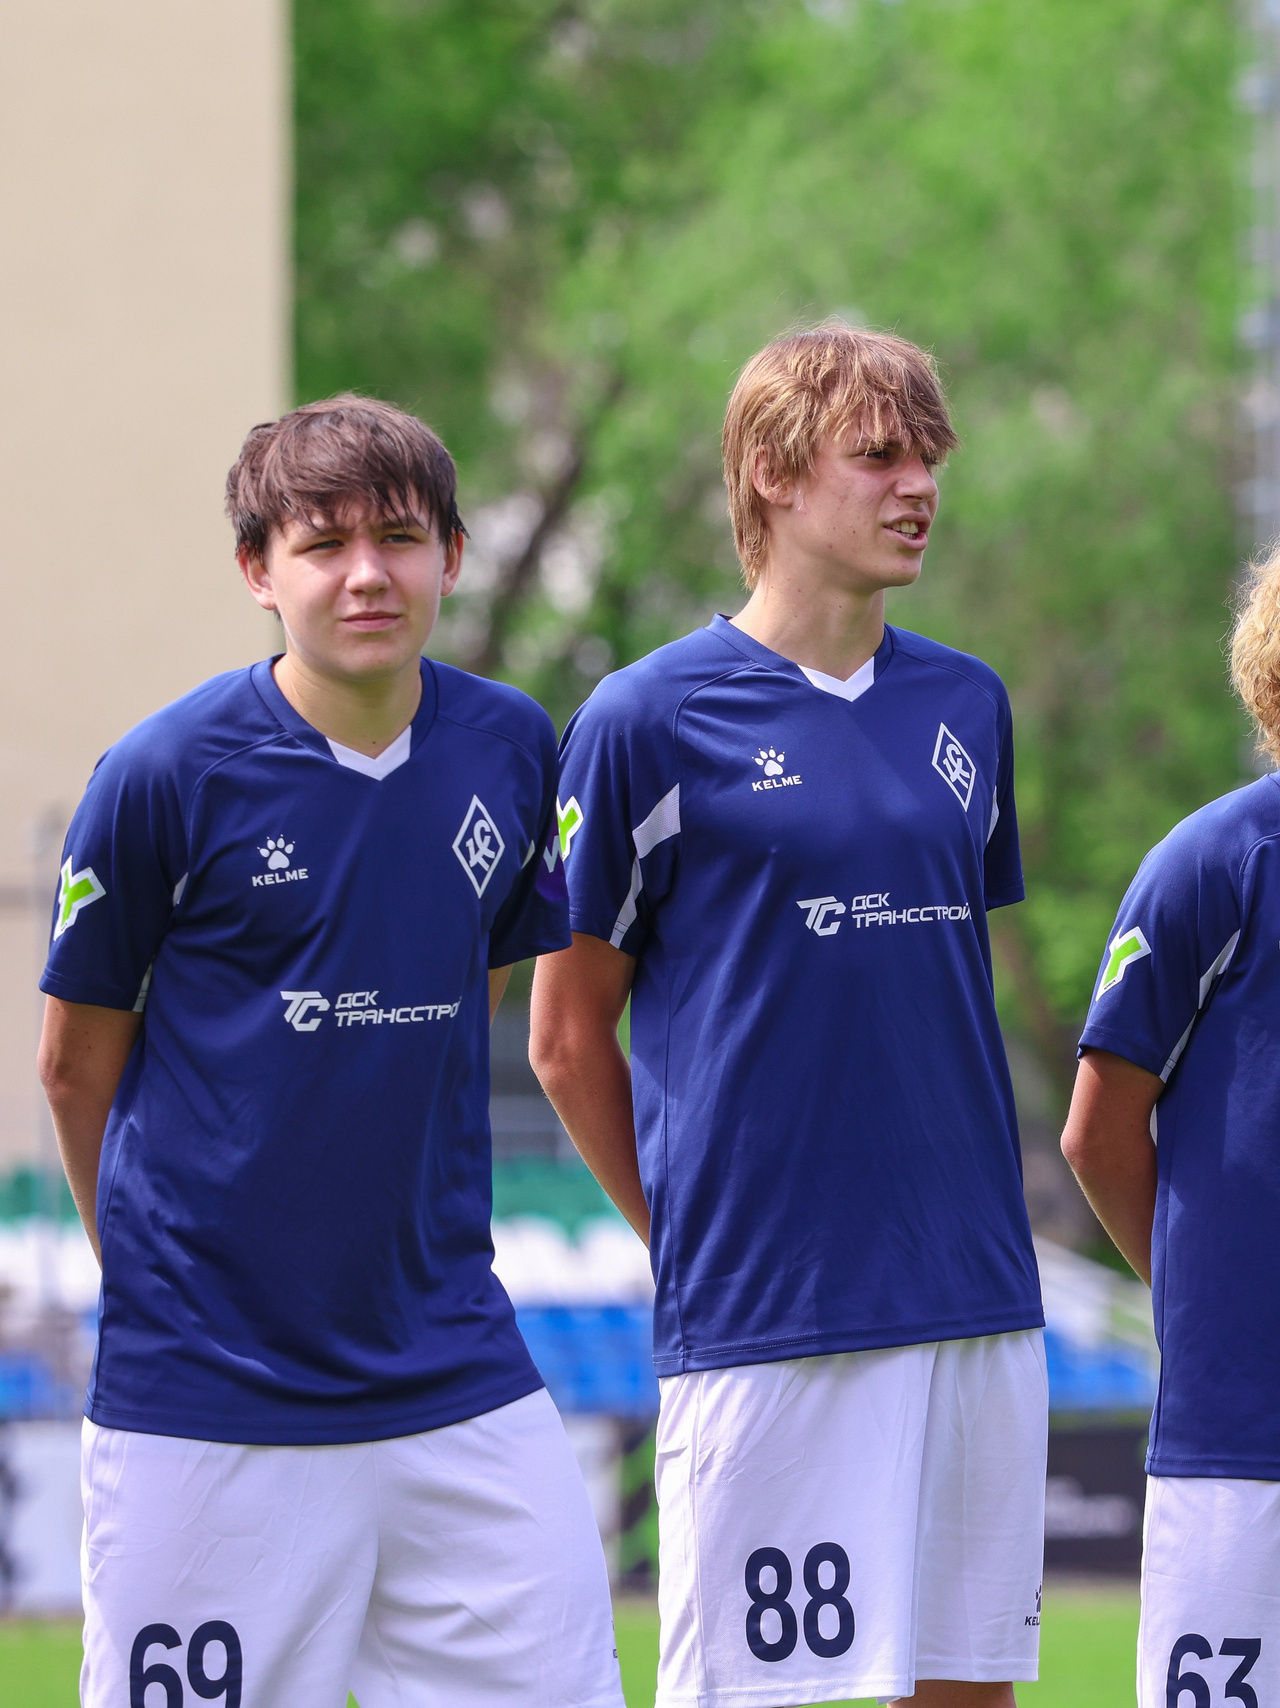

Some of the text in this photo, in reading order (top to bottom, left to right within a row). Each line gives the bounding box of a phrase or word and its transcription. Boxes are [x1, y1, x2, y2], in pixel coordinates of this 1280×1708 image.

[751, 775, 803, 792] KELME
[251, 868, 309, 887] KELME
[851, 892, 890, 912] ДСК
[851, 902, 972, 929] ТРАНССТРОЙ
[335, 990, 380, 1010] ДСК
[335, 998, 462, 1028] ТРАНССТРО
[744, 1542, 856, 1663] 88
[1024, 1616, 1040, 1626] KEL
[129, 1620, 243, 1708] 69
[1165, 1633, 1262, 1708] 63
